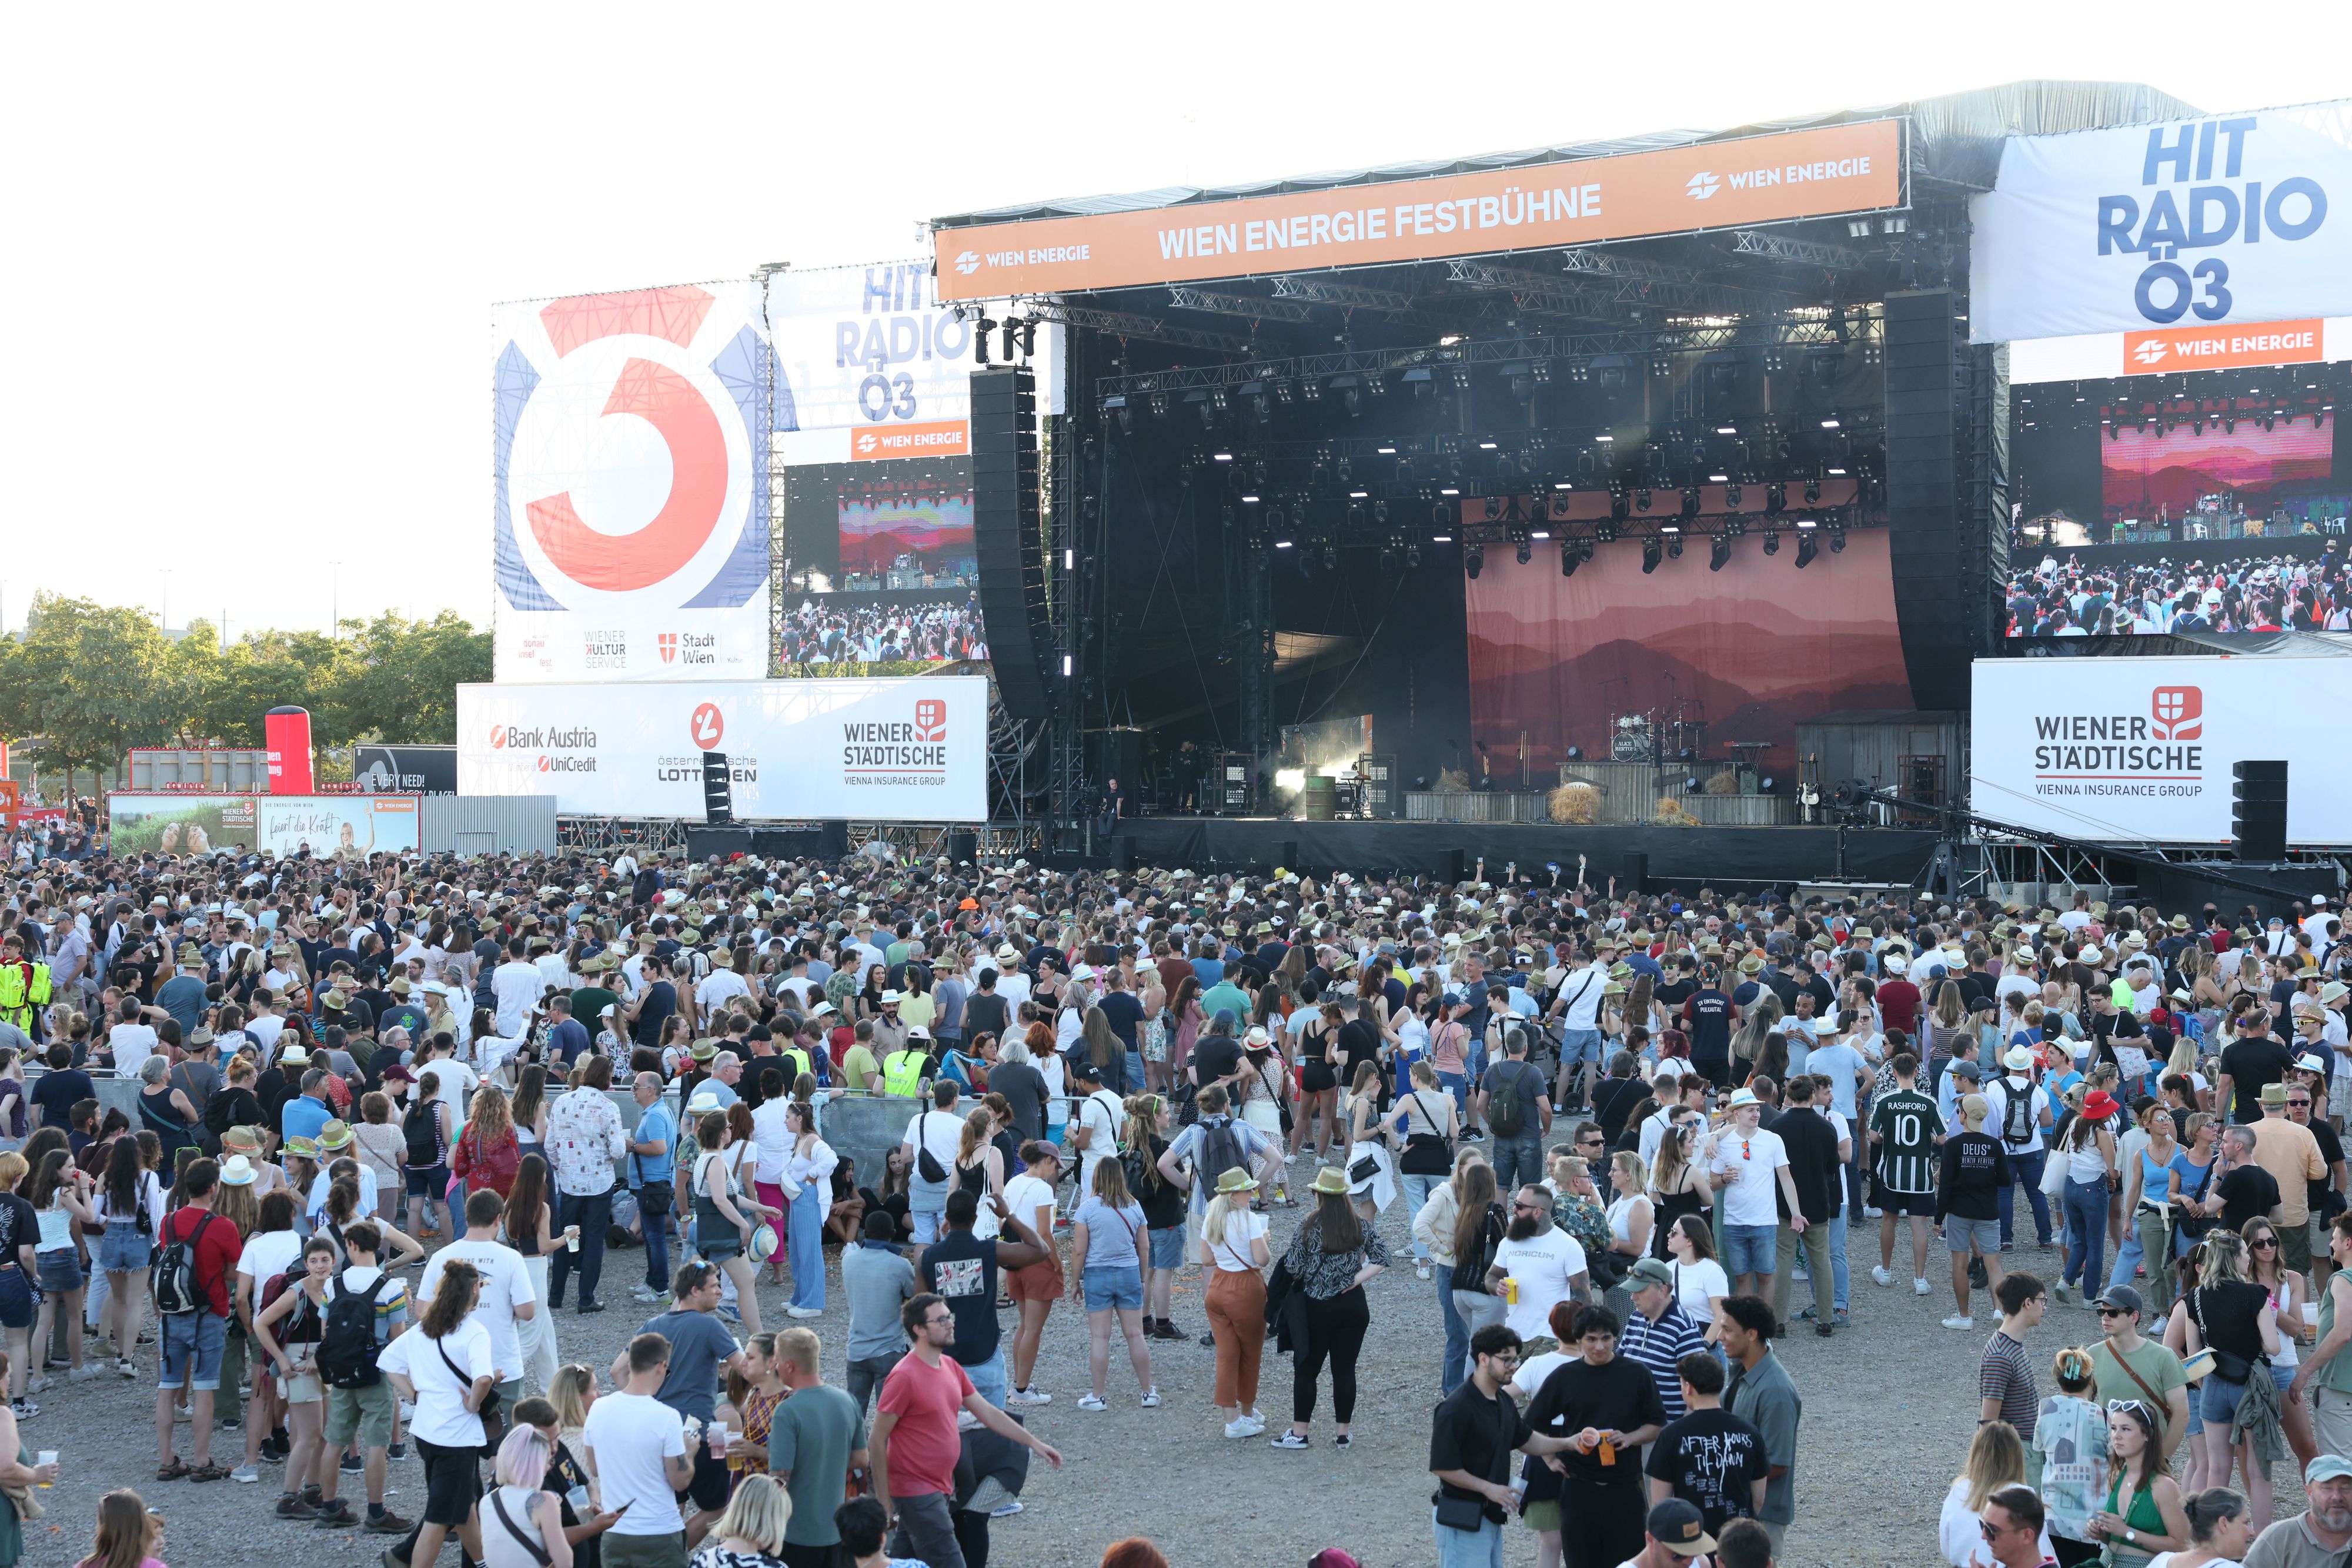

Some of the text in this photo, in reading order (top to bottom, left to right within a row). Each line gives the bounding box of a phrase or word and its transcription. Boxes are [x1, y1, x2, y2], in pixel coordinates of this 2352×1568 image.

[2142, 116, 2257, 186] HIT
[1728, 156, 1870, 190] WIEN ENERGIE
[1158, 183, 1601, 259] WIEN ENERGIE FESTBÜHNE
[2097, 176, 2328, 256] RADIO
[985, 245, 1090, 268] WIEN ENERGIE
[863, 263, 929, 315] HIT
[2134, 241, 2233, 324] Ö3
[836, 312, 970, 368] RADIO
[2174, 331, 2314, 359] WIEN ENERGIE
[858, 357, 917, 422] Ö3
[881, 432, 963, 447] WIEN ENERGIE
[523, 639, 544, 647] donau
[584, 630, 626, 642] WIENER
[683, 633, 714, 647] Stadt
[519, 649, 534, 658] insel
[586, 644, 626, 655] KULTUR
[683, 650, 714, 663] Wien
[586, 657, 626, 668] SERVICE
[508, 726, 596, 748] Bank Austria
[844, 723, 913, 742] WIENER
[2035, 716, 2147, 740] WIENER
[551, 757, 596, 772] UniCredit
[658, 755, 757, 765] österresche
[844, 746, 946, 765] STÄDTISCHE
[2035, 745, 2202, 770] STÄDTISCHE
[372, 774, 425, 787] EVERY NEED!
[844, 777, 946, 785] VIENNA INSURANCE GROUP
[2036, 784, 2203, 797] VIENNA INSURANCE GROUP
[270, 811, 340, 840] feiert die Kraft
[282, 839, 295, 857] der
[1887, 1102, 1927, 1111] RASHFORD
[1895, 1114, 1920, 1146] 10
[1508, 1251, 1555, 1260] NORICUM
[1680, 1432, 1753, 1455] AFTER HOURS
[1716, 1452, 1743, 1469] DAWN
